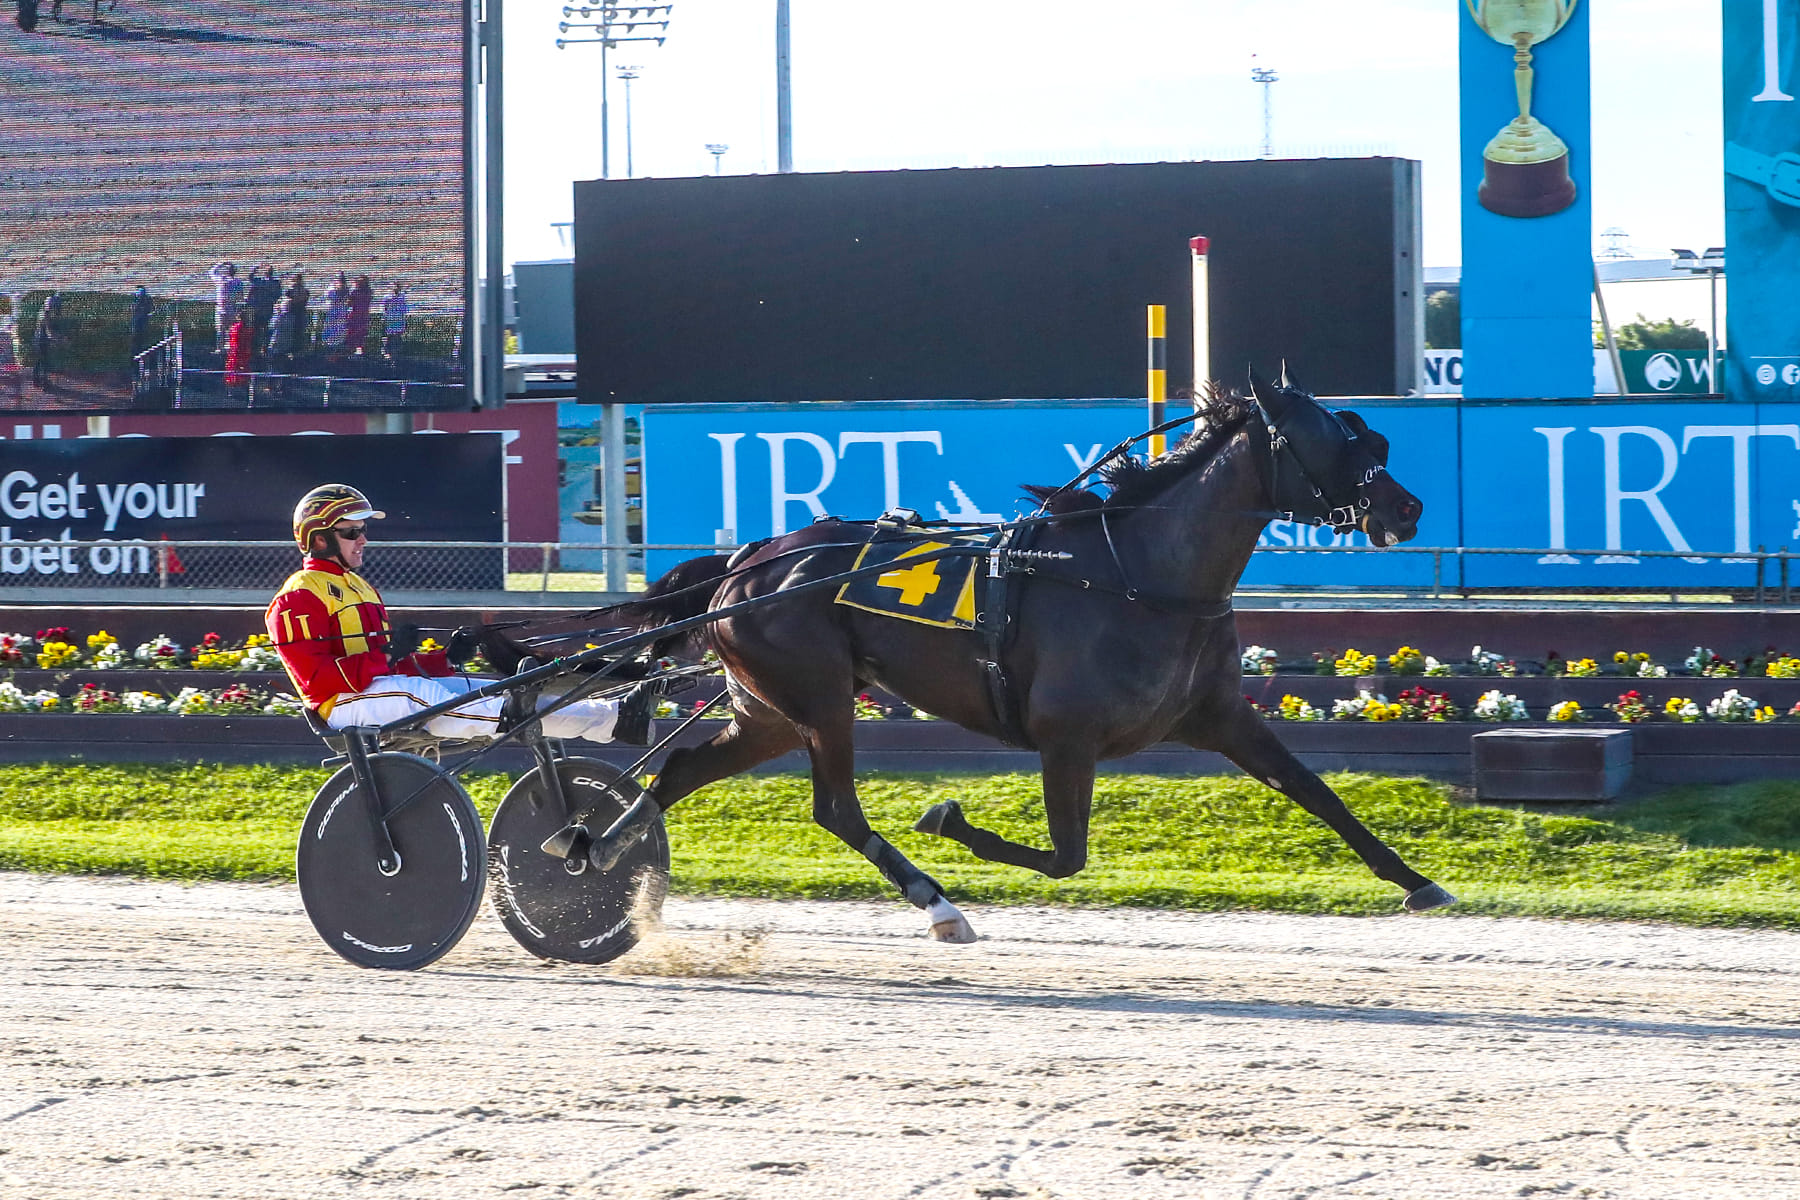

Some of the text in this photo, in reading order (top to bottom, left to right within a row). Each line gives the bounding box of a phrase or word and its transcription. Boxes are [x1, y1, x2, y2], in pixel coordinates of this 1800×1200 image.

[1, 471, 205, 531] Get your
[708, 431, 944, 555] IRT
[1533, 424, 1800, 565] IRT
[1, 527, 150, 575] bet on
